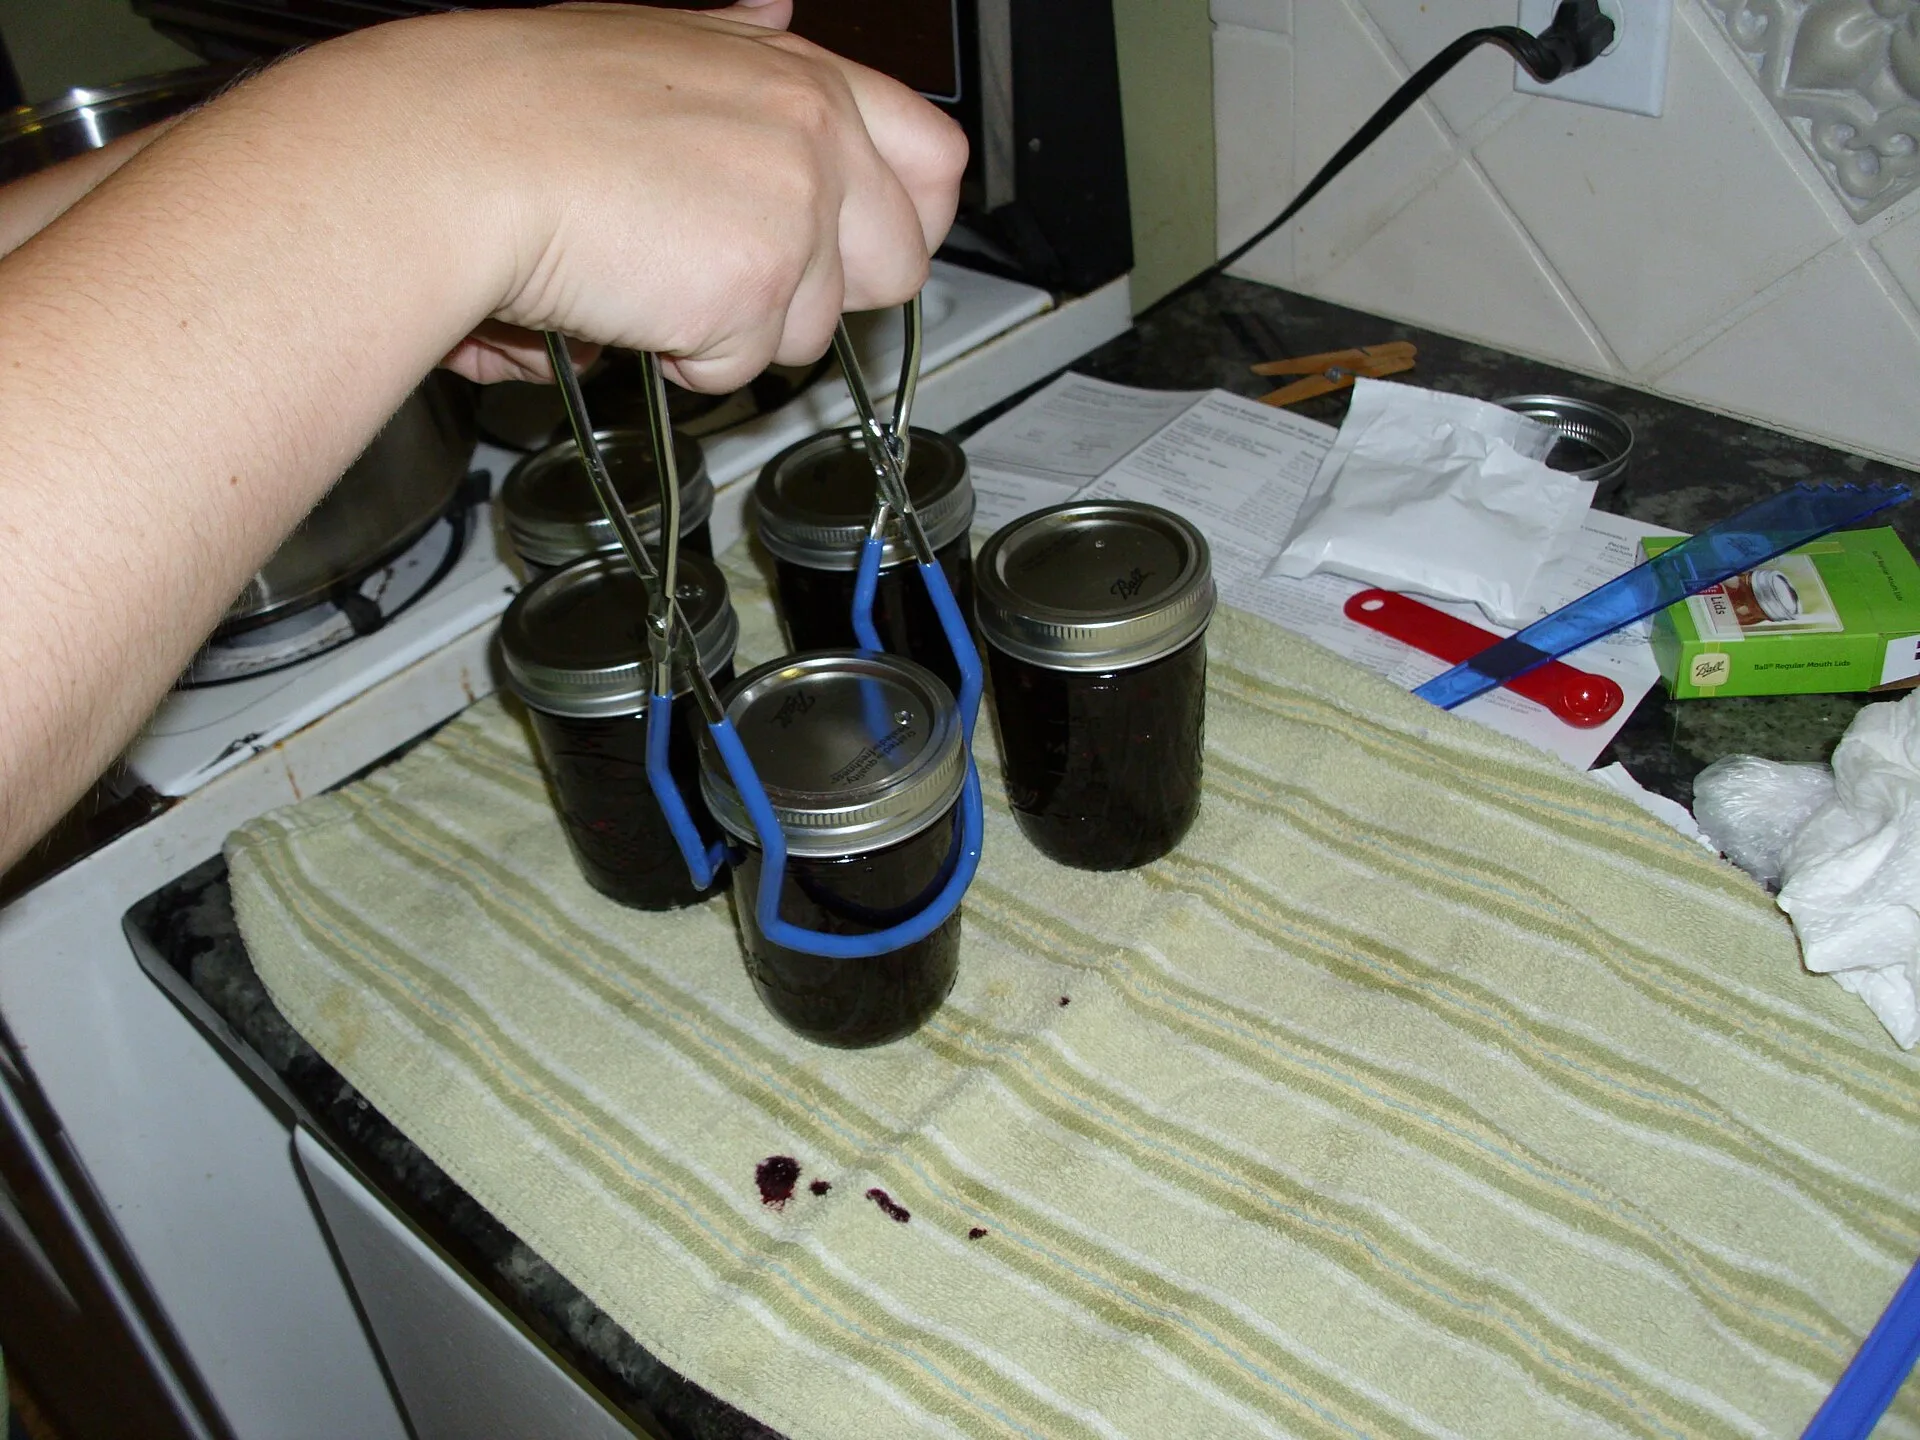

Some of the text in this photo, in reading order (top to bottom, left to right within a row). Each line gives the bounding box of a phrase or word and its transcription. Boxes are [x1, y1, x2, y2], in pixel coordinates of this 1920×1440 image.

[1111, 567, 1155, 600] Ball
[1710, 596, 1725, 615] Lids
[1696, 660, 1725, 678] Ball
[1775, 662, 1806, 671] Regular
[1807, 660, 1833, 669] Mouth
[1834, 660, 1851, 668] Lids
[846, 758, 878, 784] quality
